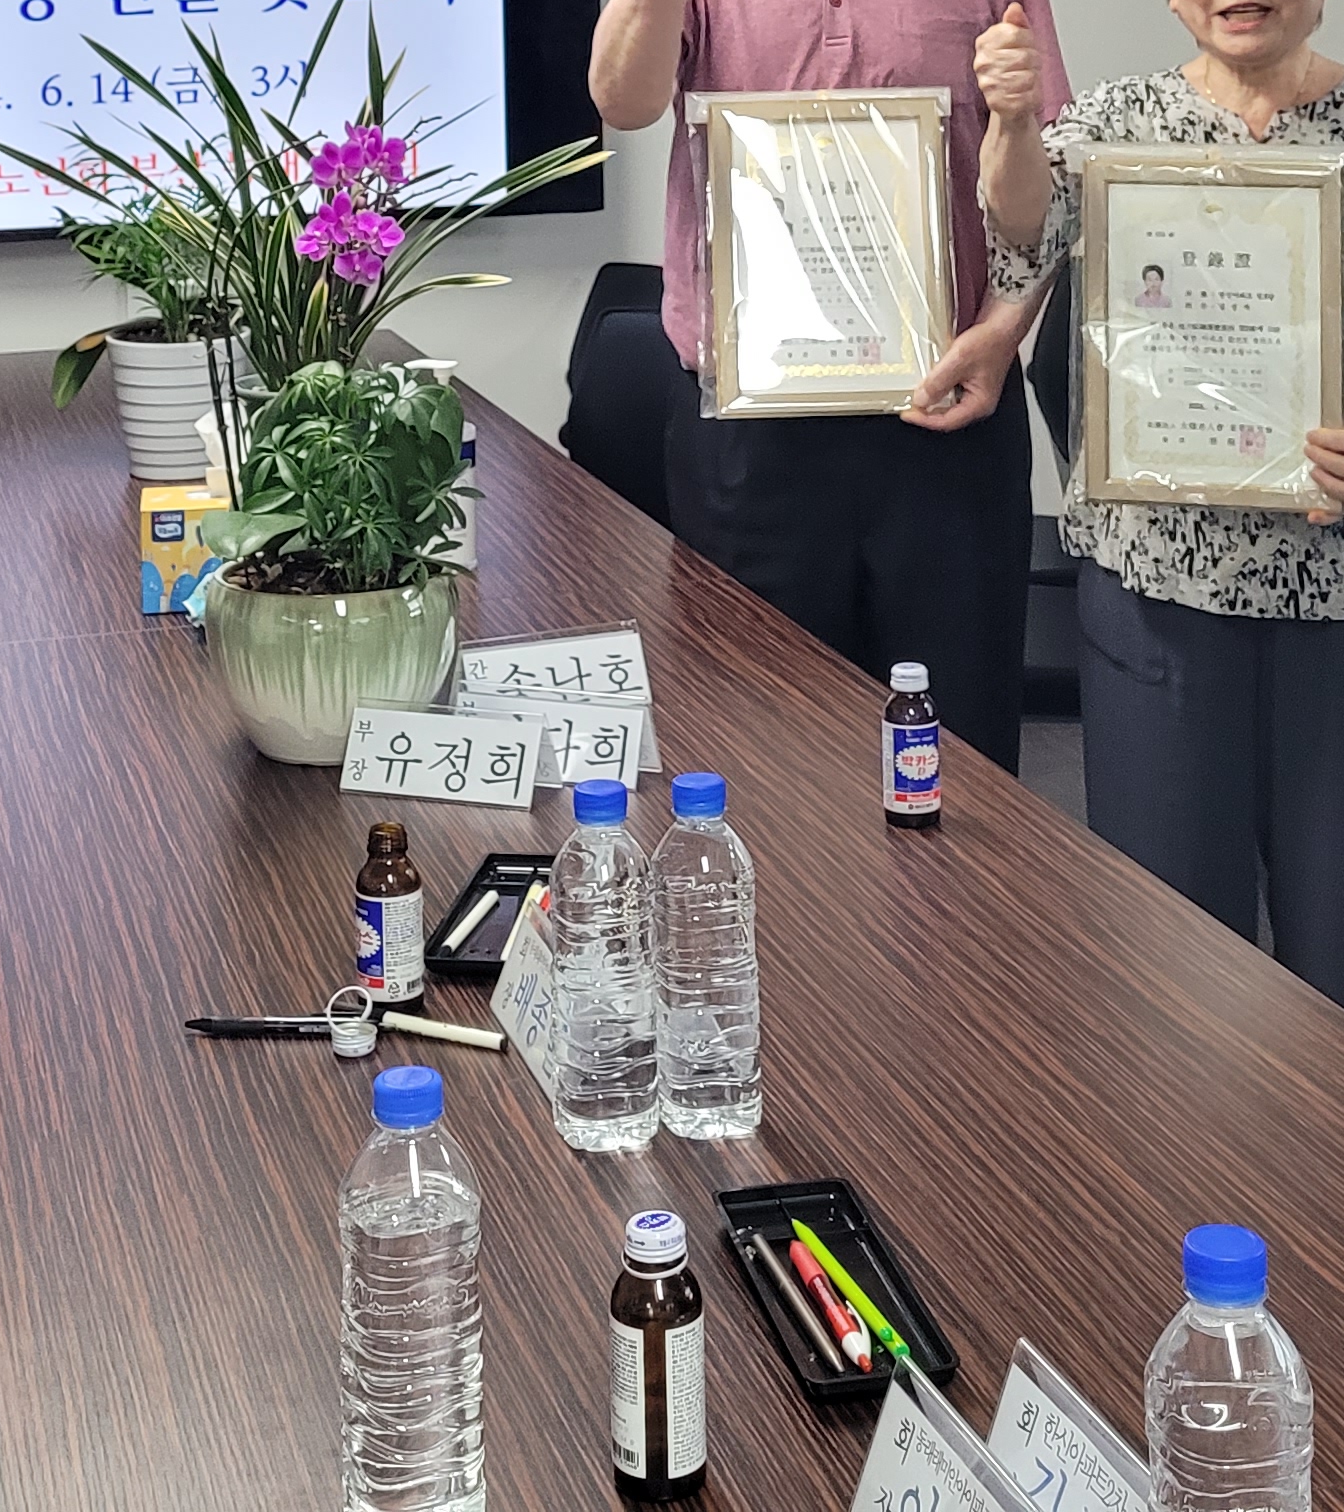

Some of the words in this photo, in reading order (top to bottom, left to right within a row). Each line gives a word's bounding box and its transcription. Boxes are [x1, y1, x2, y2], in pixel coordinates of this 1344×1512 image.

[41, 73, 74, 106] 6.
[91, 73, 134, 103] 14
[374, 731, 529, 800] 유정희
